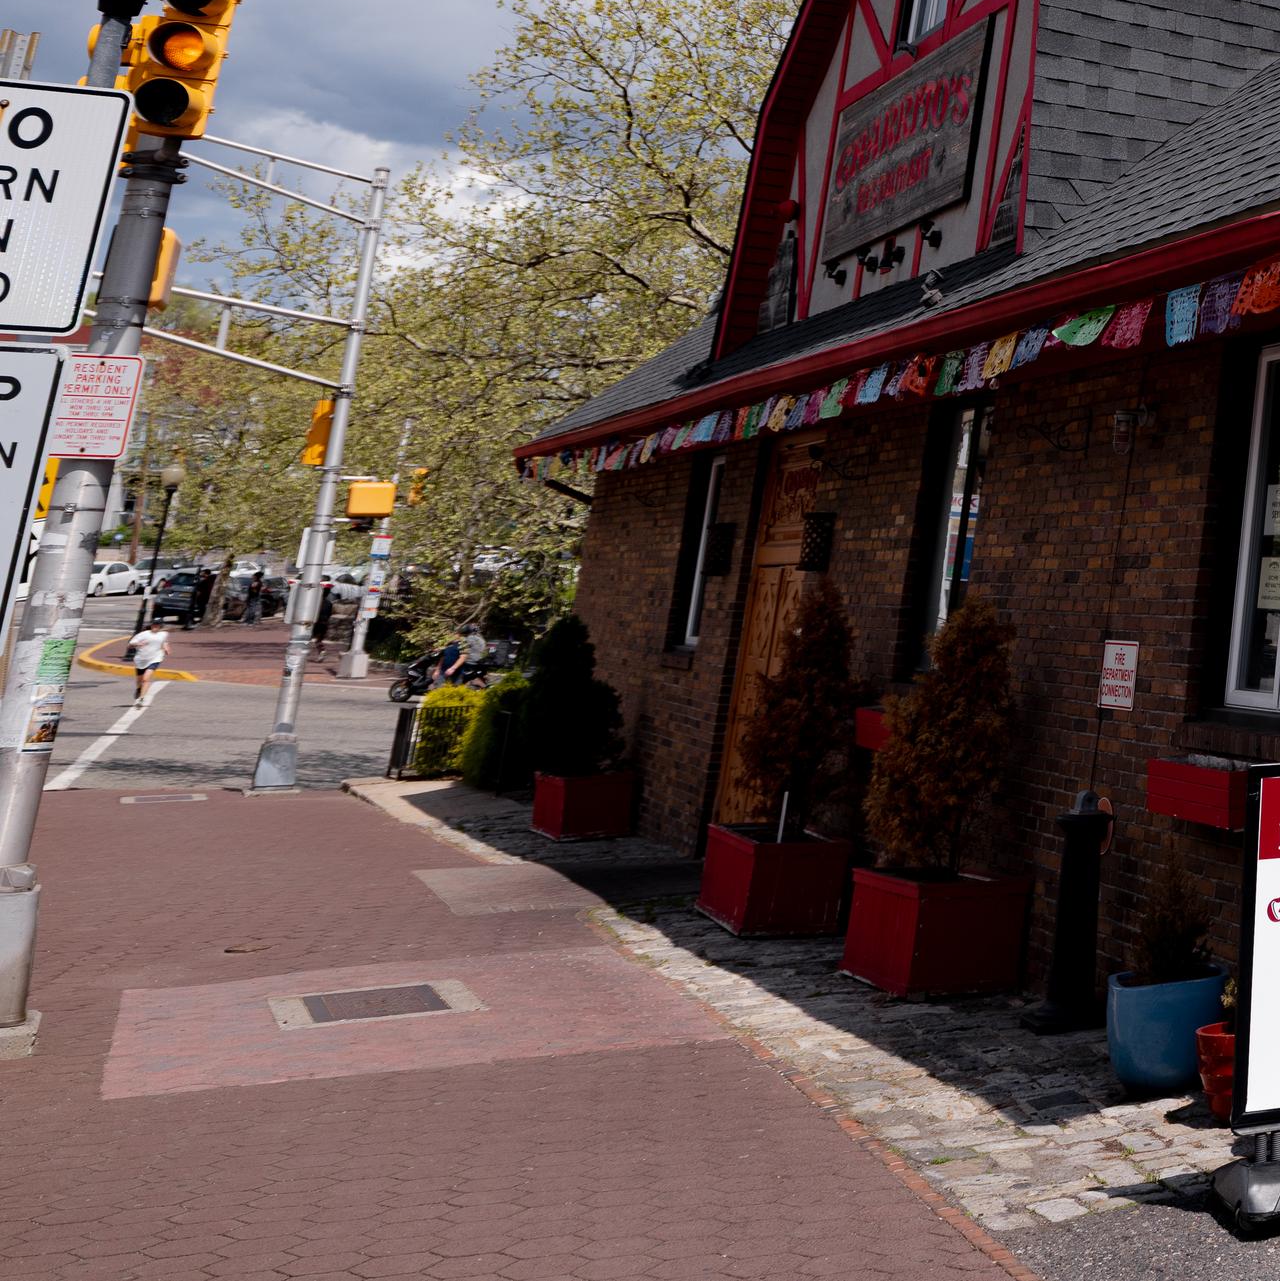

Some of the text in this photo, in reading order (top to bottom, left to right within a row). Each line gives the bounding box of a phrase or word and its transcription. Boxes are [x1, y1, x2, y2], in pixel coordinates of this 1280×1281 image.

[74, 363, 128, 374] RESIDENT
[76, 374, 121, 384] PARKING
[104, 385, 131, 395] ONLY
[1114, 653, 1126, 666] FIRE
[1102, 668, 1135, 681] DEPARTMENT
[1102, 684, 1132, 698] CONNECTION
